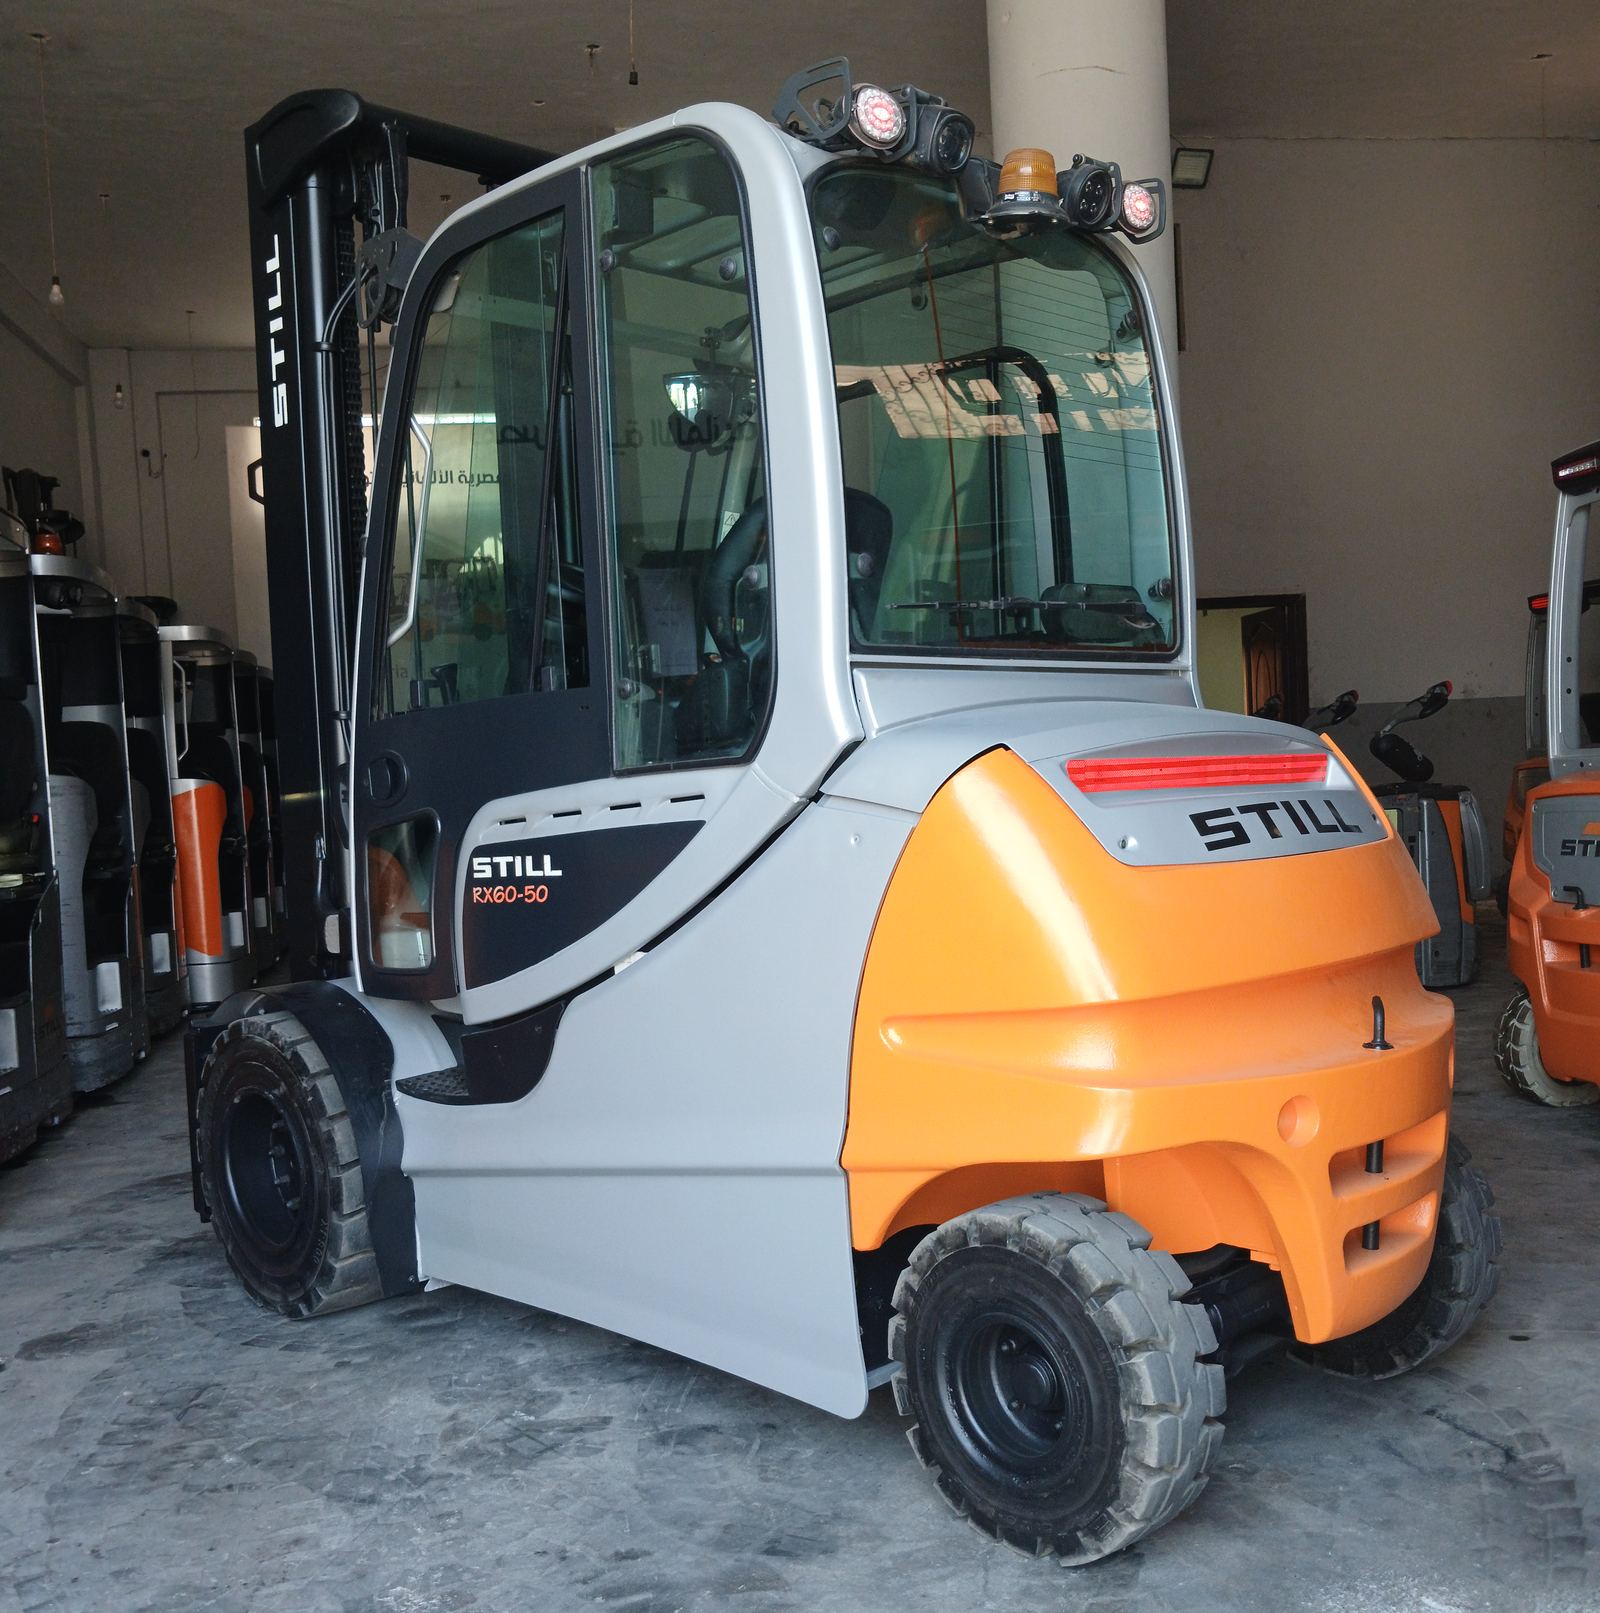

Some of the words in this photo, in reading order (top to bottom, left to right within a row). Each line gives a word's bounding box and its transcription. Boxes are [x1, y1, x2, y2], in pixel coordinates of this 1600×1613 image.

[265, 233, 288, 428] STILL
[1188, 799, 1363, 851] STILL
[472, 854, 562, 878] STILL
[472, 884, 548, 903] RX60-50
